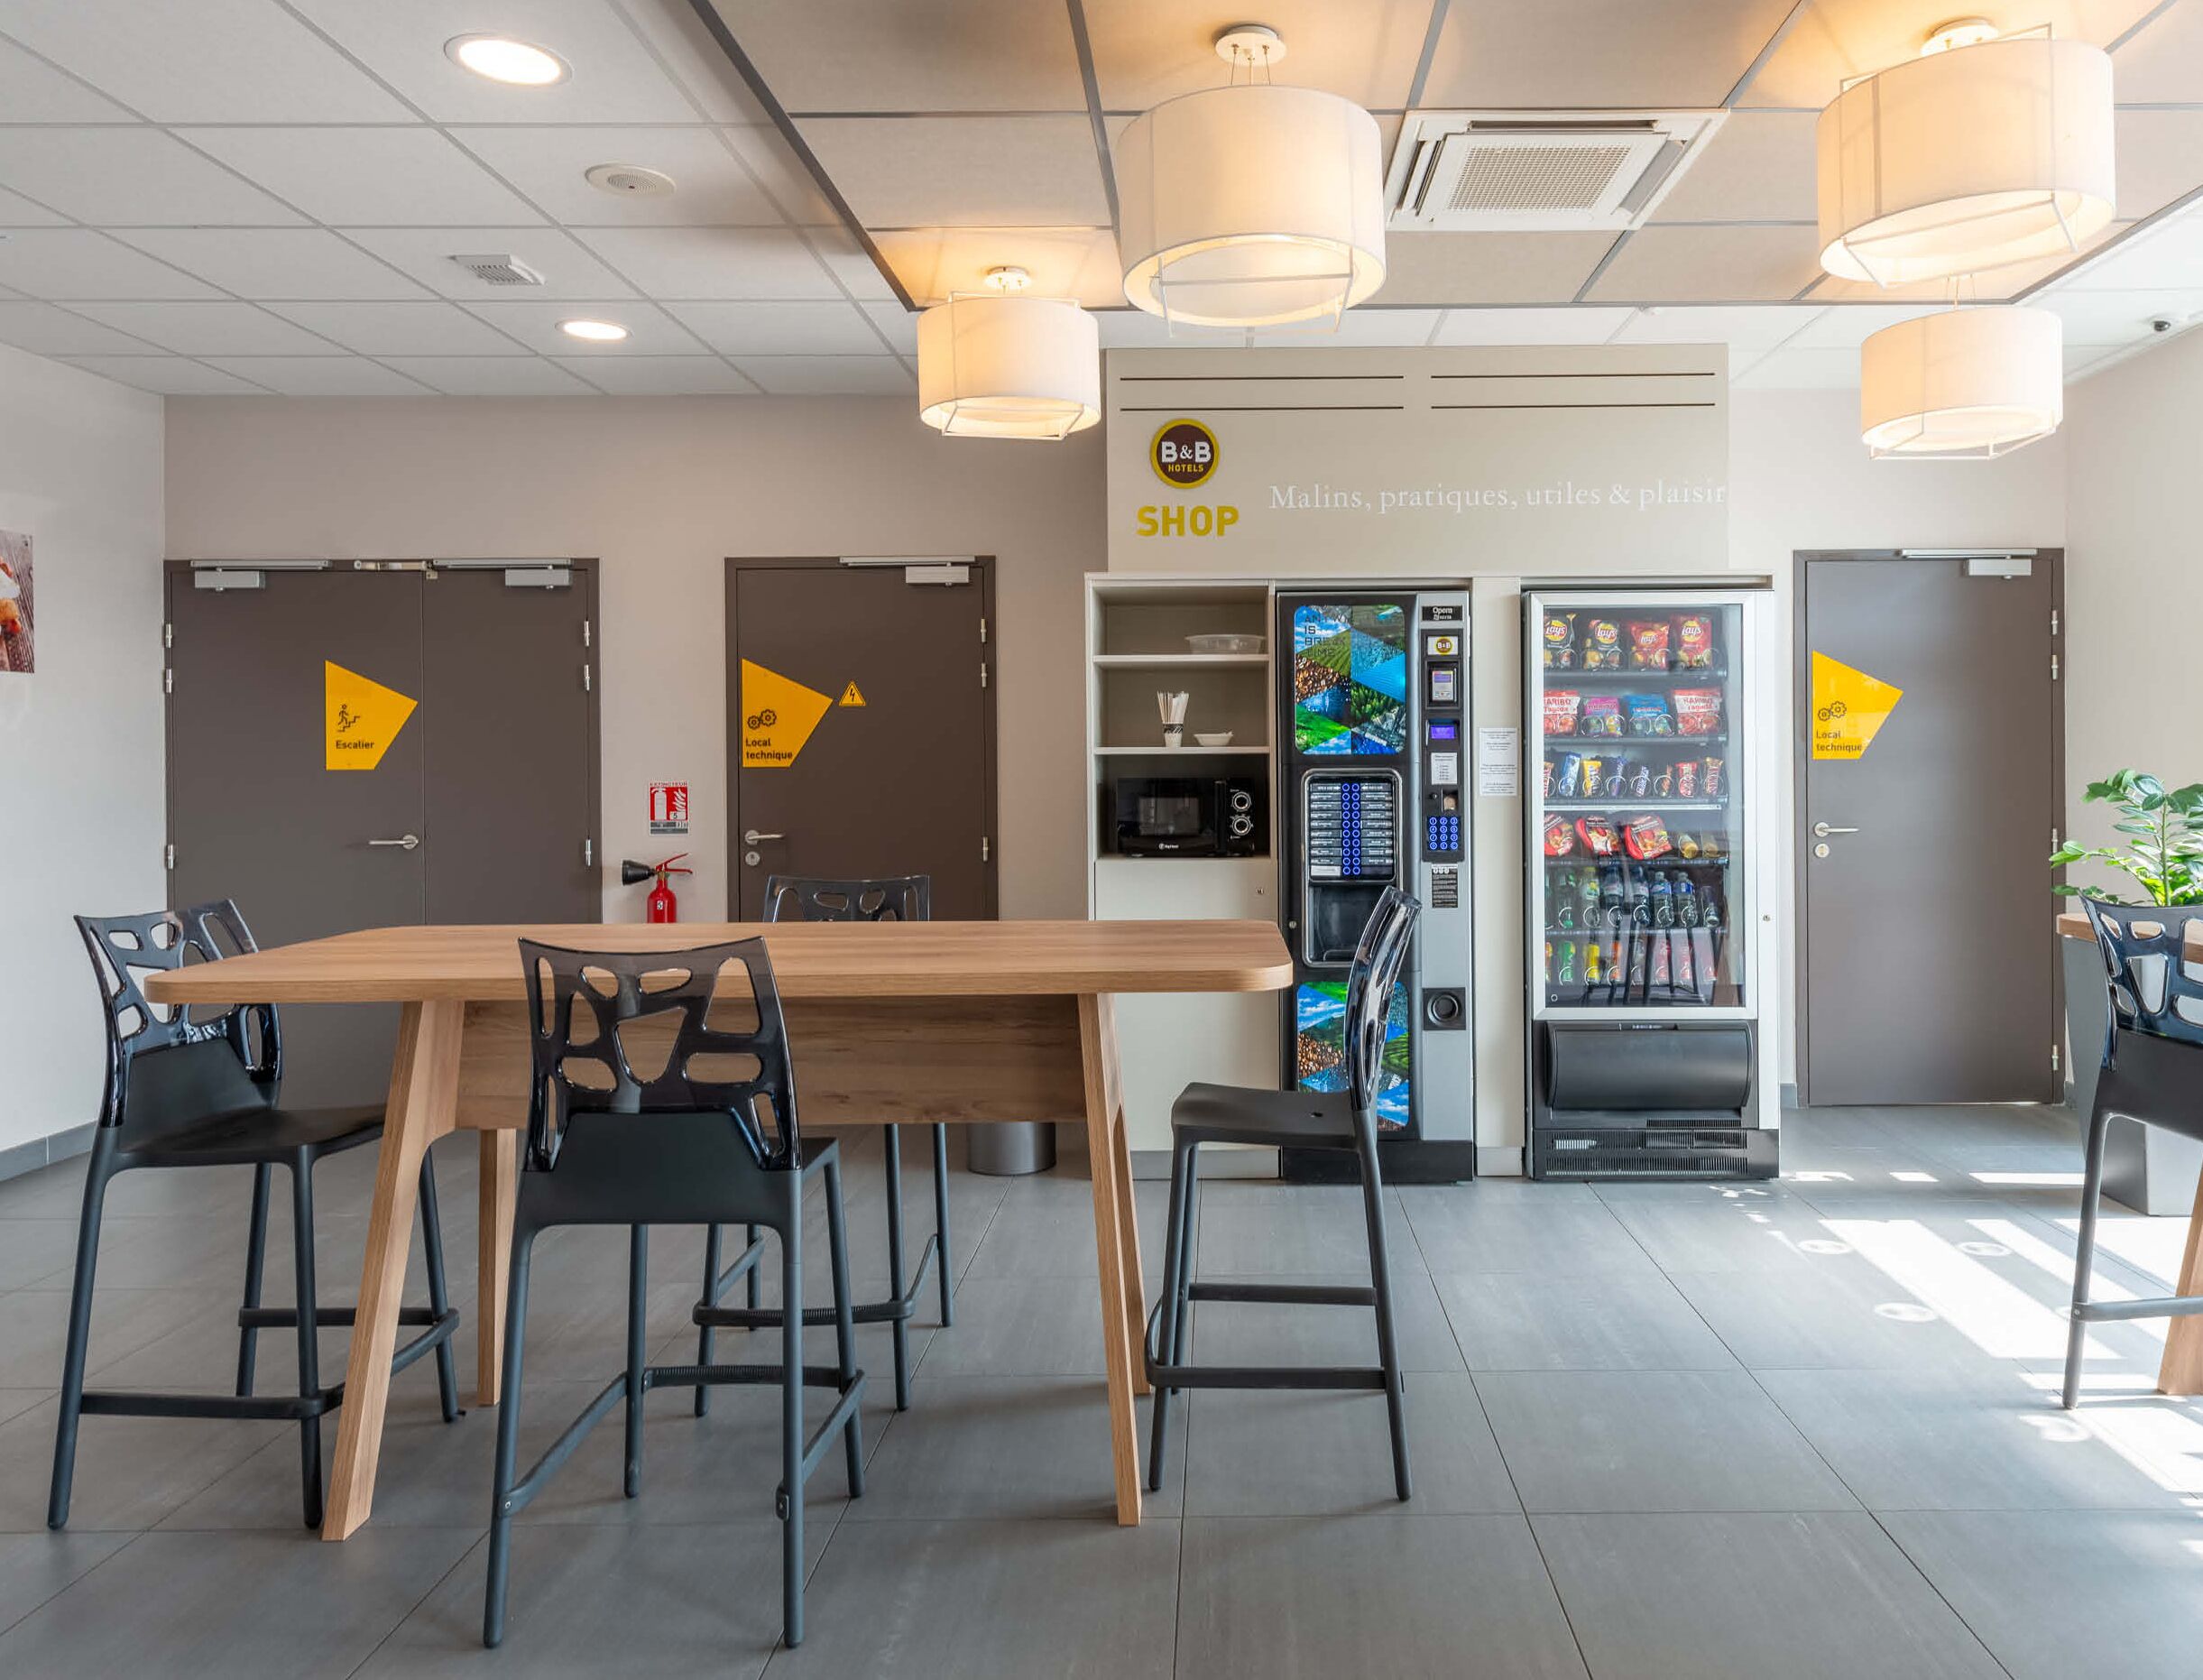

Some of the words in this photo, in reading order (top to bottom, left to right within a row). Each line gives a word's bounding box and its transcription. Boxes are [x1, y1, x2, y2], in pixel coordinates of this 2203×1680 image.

[1161, 441, 1212, 463] B&B
[1168, 464, 1204, 473] HOTELS
[1269, 484, 1371, 511] Malins,
[1378, 483, 1517, 513] pratiques,
[1526, 481, 1601, 506] utiles
[1609, 484, 1631, 504] &
[1137, 505, 1240, 537] SHOP
[1816, 730, 1841, 739] Local
[336, 740, 374, 749] Escalier
[745, 738, 771, 747] Local
[1816, 743, 1862, 752] technique
[746, 751, 793, 761] technique
